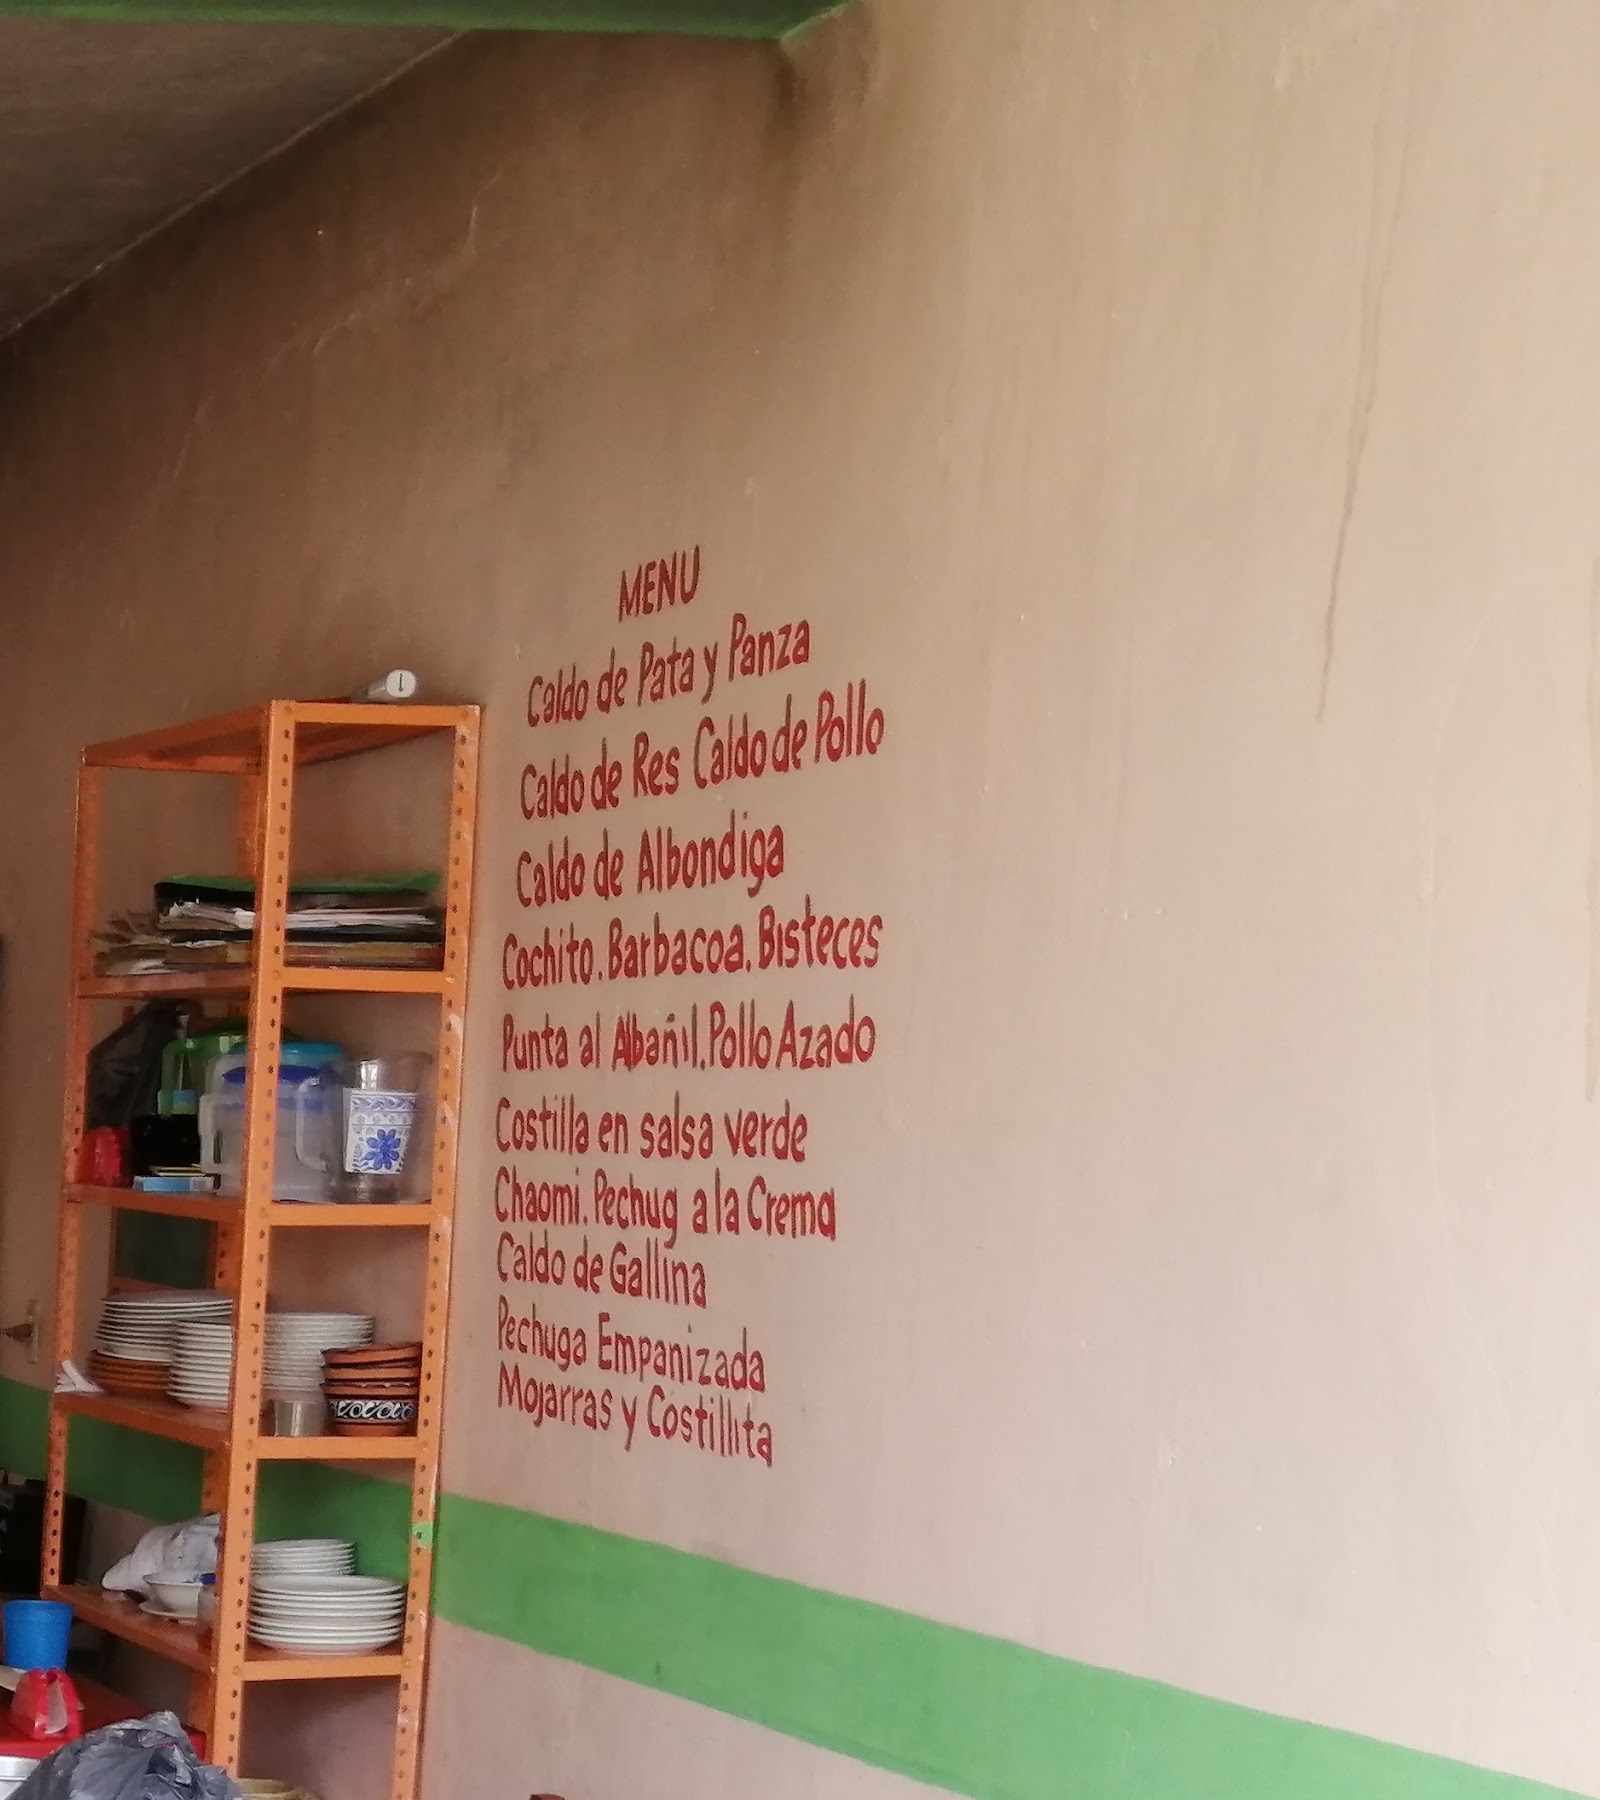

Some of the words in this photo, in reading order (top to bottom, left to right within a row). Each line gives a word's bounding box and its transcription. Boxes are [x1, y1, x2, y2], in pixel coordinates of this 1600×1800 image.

[618, 545, 700, 623] MENU
[528, 663, 589, 727] Caldo
[597, 647, 628, 714] de
[637, 636, 694, 707] Pata
[701, 641, 718, 705] y
[728, 613, 810, 682] Panza
[521, 753, 585, 820] Caldo
[590, 737, 622, 810] de
[633, 731, 680, 798] Res
[693, 712, 767, 789] Caldo
[771, 693, 807, 773] de
[814, 678, 884, 764] Pollo
[516, 836, 585, 908] Caldo
[593, 827, 624, 901] de
[637, 809, 784, 898] Albondiga
[502, 1012, 568, 1072] Punta
[579, 1011, 601, 1069] al
[709, 998, 772, 1070] Pollo
[775, 994, 876, 1070] Azado
[496, 1093, 589, 1155] Costilla
[598, 1112, 628, 1154] en
[640, 1090, 713, 1160] salsa
[723, 1099, 807, 1163] verde
[594, 1168, 677, 1251] Pechug
[692, 1188, 708, 1235] a
[715, 1167, 739, 1235] la
[747, 1174, 836, 1242] Crema
[497, 1229, 566, 1285] Caldo
[573, 1235, 603, 1294] de
[609, 1235, 706, 1309] Gallina
[498, 1295, 586, 1375] Pechuga
[598, 1312, 765, 1395] Empanizada
[498, 1359, 612, 1431] Mojarras
[621, 1396, 637, 1452] y
[647, 1382, 772, 1468] Costillita
